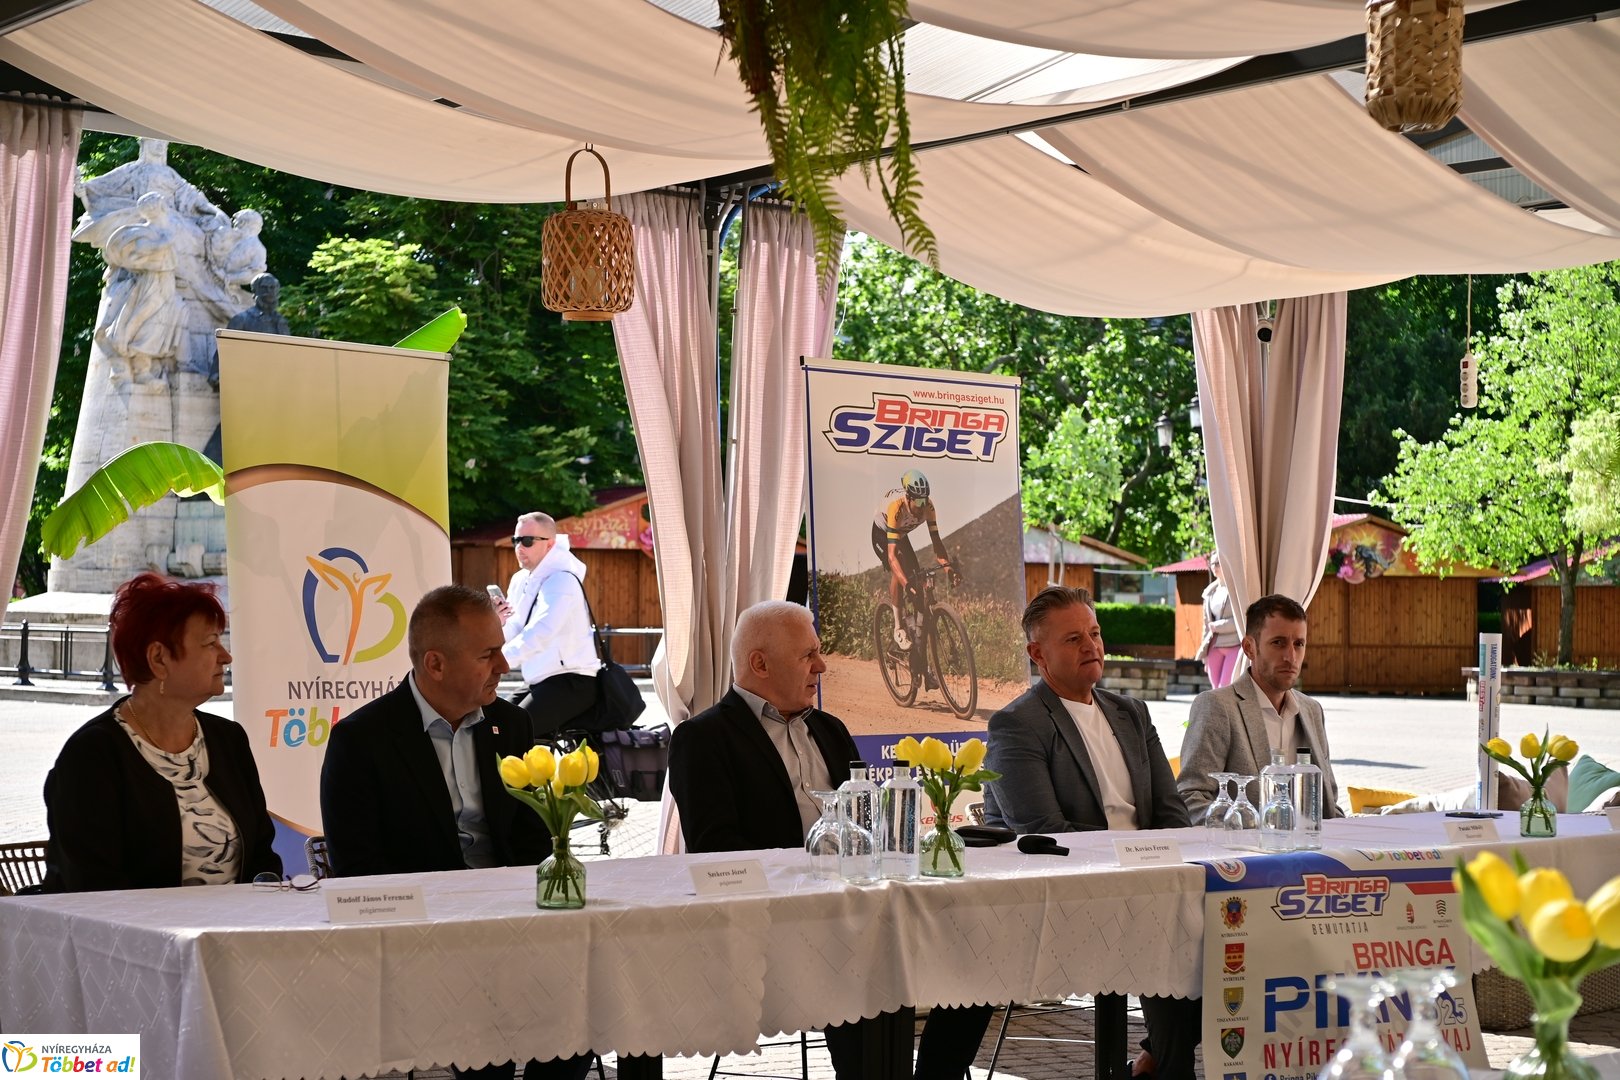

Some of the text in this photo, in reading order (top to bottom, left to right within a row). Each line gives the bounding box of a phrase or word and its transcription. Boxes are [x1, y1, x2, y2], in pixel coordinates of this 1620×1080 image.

[913, 389, 1005, 405] www.bringasziget.hu
[875, 399, 1005, 433] BRINGA
[832, 411, 1002, 456] SZIGET
[289, 676, 403, 700] NYÍREGYHÁ
[1306, 876, 1388, 898] BRINGA
[1280, 889, 1386, 916] SZIGET
[1311, 921, 1369, 936] BEMUTATJA
[1352, 938, 1456, 970] BRINGA
